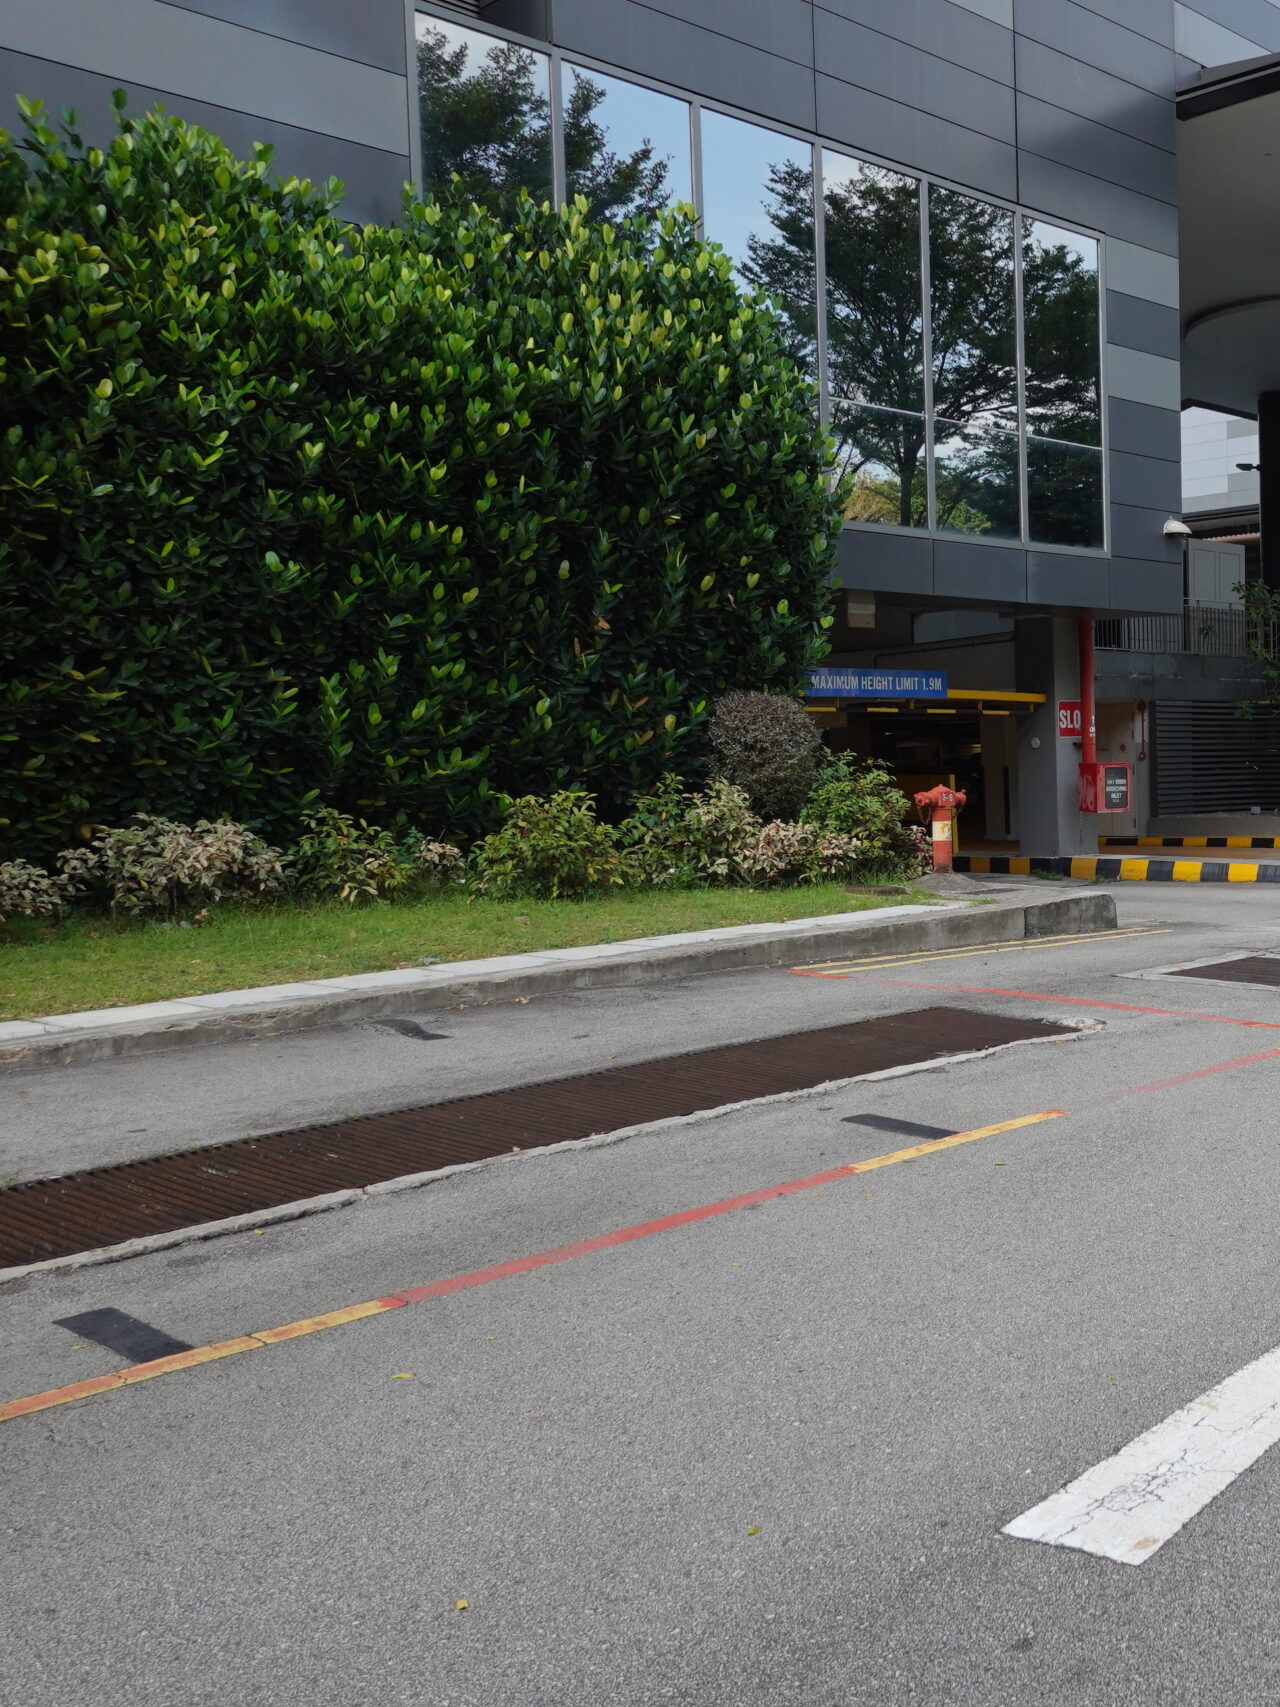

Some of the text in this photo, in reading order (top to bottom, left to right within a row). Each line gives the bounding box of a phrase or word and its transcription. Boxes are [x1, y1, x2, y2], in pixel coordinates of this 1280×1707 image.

[811, 675, 942, 691] MAXIMUM HEIGHT LIMIT 1.9M
[1059, 709, 1082, 729] SLO
